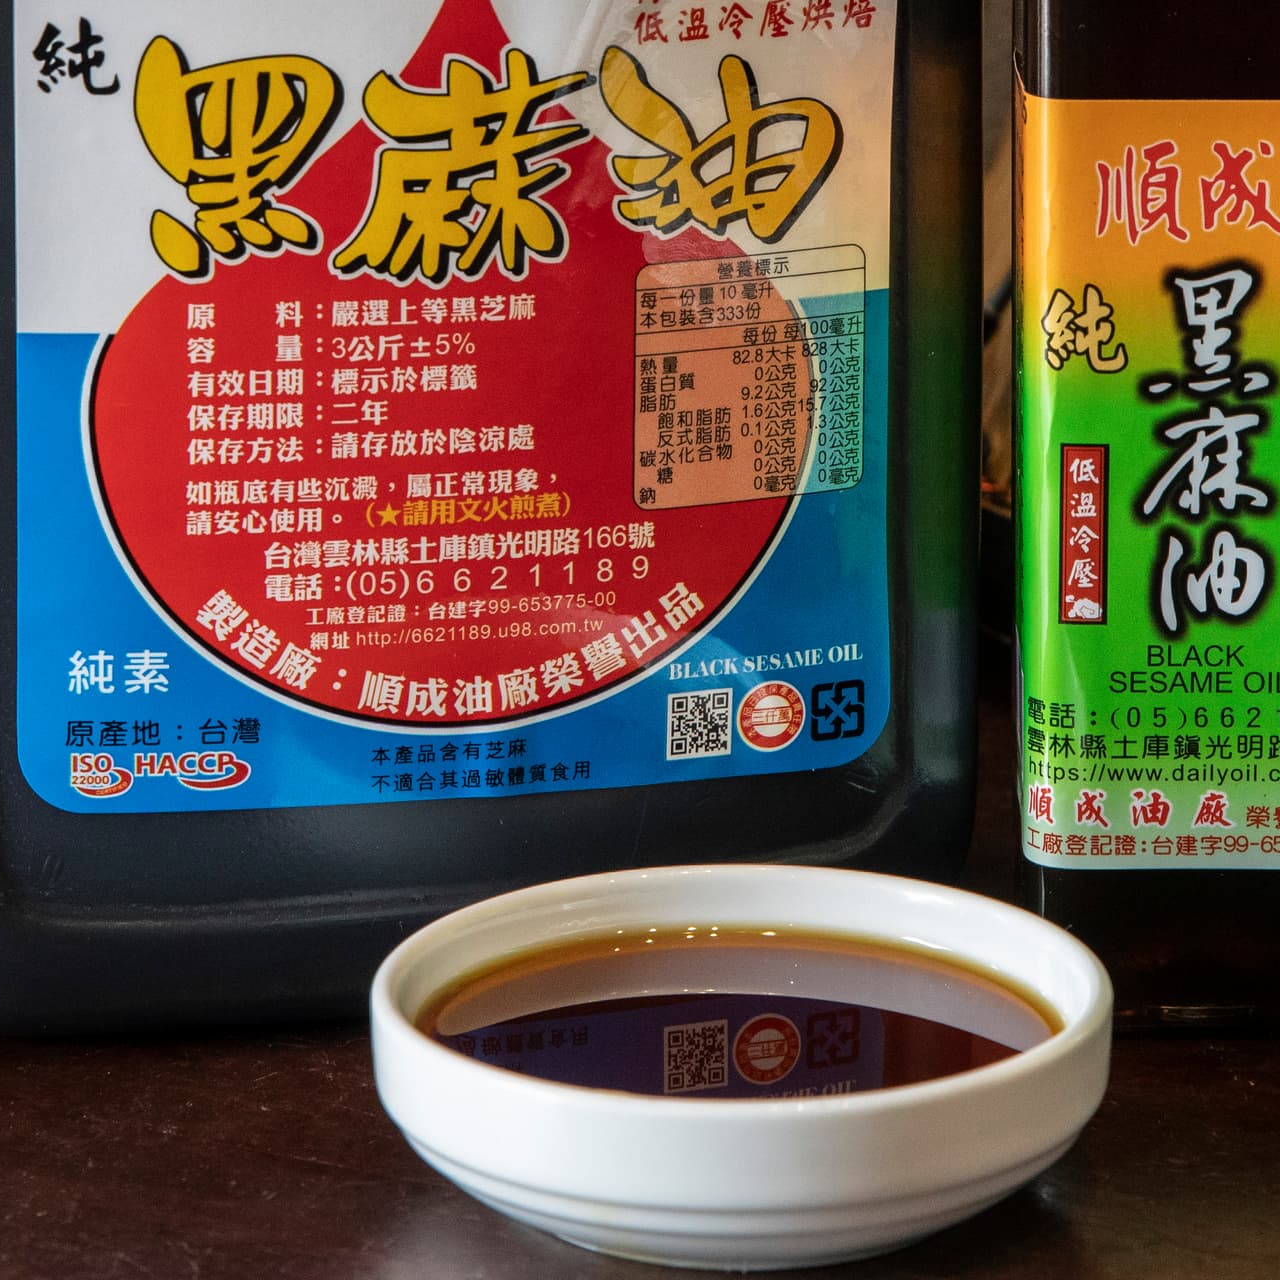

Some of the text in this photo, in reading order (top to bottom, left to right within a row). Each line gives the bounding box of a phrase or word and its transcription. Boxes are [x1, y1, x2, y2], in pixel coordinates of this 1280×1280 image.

[32, 17, 120, 95] 純
[717, 256, 789, 280] 營養標示
[1041, 283, 1128, 374] 純
[640, 372, 695, 394] 蛋白質
[640, 394, 677, 413] 脂肪
[658, 407, 731, 429] 飽和脂肪
[657, 426, 731, 447] 反式脂肪
[640, 444, 733, 467] 碳水化合物
[657, 468, 673, 485] 糖
[310, 632, 351, 650] 網址
[669, 643, 863, 681] BLACK SESAME OIL
[1146, 645, 1245, 668] BLACK
[68, 649, 171, 696] 純素
[1109, 672, 1234, 695] SESAME
[64, 717, 262, 748] 原產地：台灣
[71, 754, 113, 773] ISO
[371, 738, 528, 766] 本產品含有芝麻
[134, 752, 235, 776] HACCP
[71, 775, 110, 785] 22000
[371, 760, 591, 793] 不適合其過敏體質食用
[1029, 785, 1232, 828] 順成油廠
